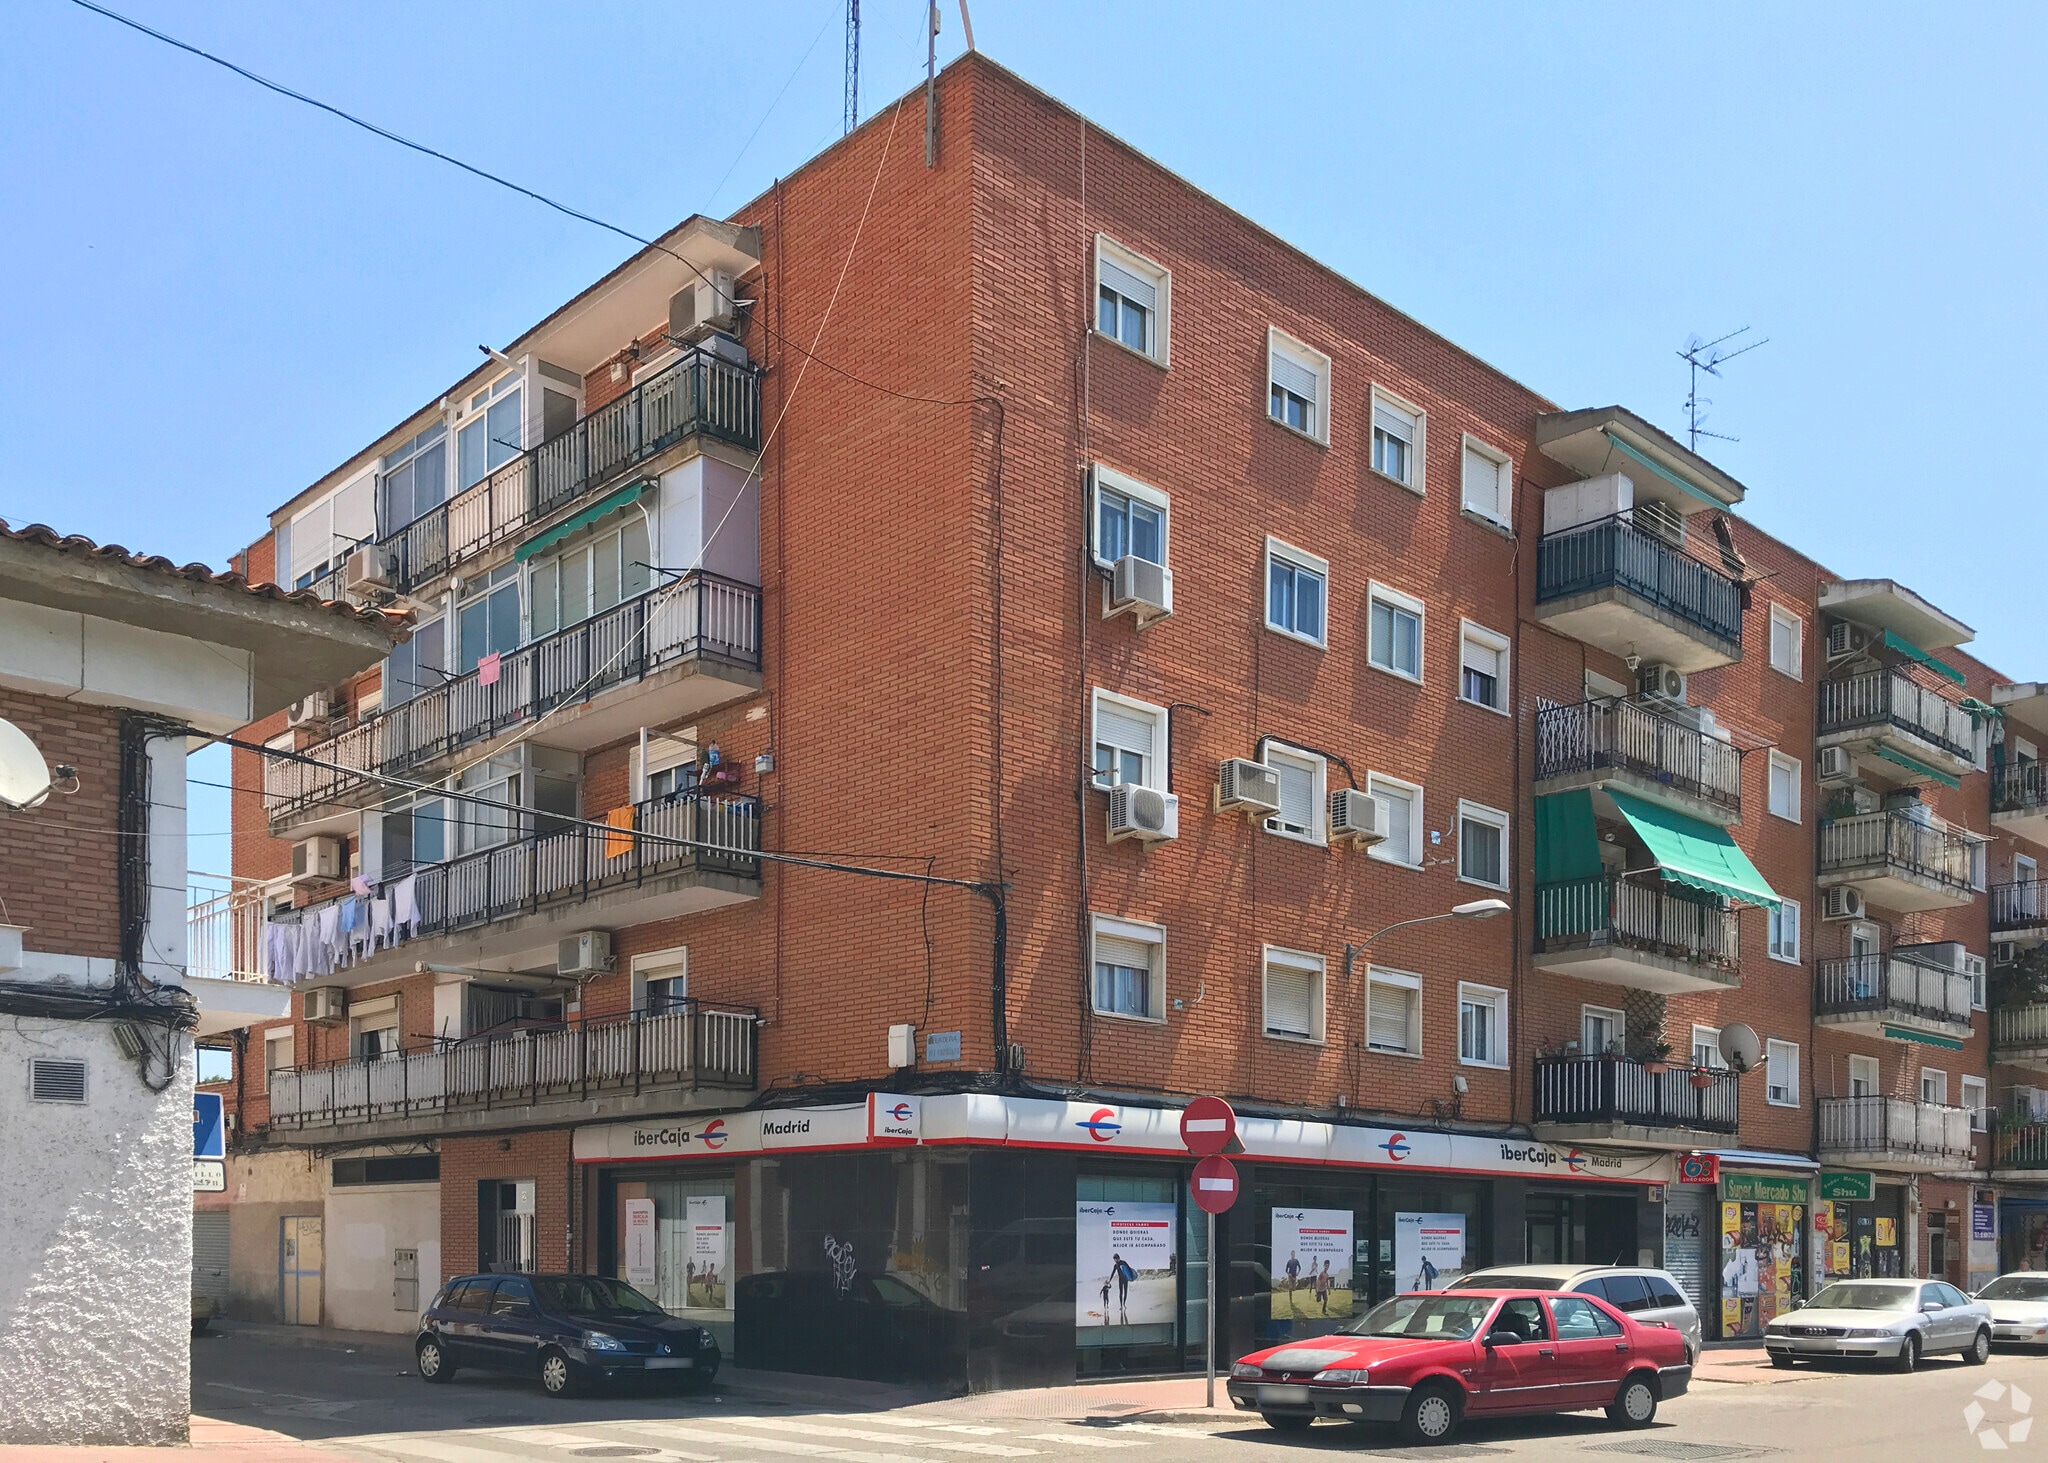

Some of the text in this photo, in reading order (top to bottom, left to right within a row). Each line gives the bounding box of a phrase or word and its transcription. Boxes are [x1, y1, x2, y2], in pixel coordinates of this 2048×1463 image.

[634, 1119, 810, 1147] iberCaja Madrid
[884, 1126, 913, 1135] iberCaja
[1501, 1143, 1622, 1168] iberCaja Madrid
[1728, 1179, 1807, 1201] Super Mercado Shu
[1832, 1187, 1857, 1197] Shu
[1080, 1207, 1103, 1215] iberCaja
